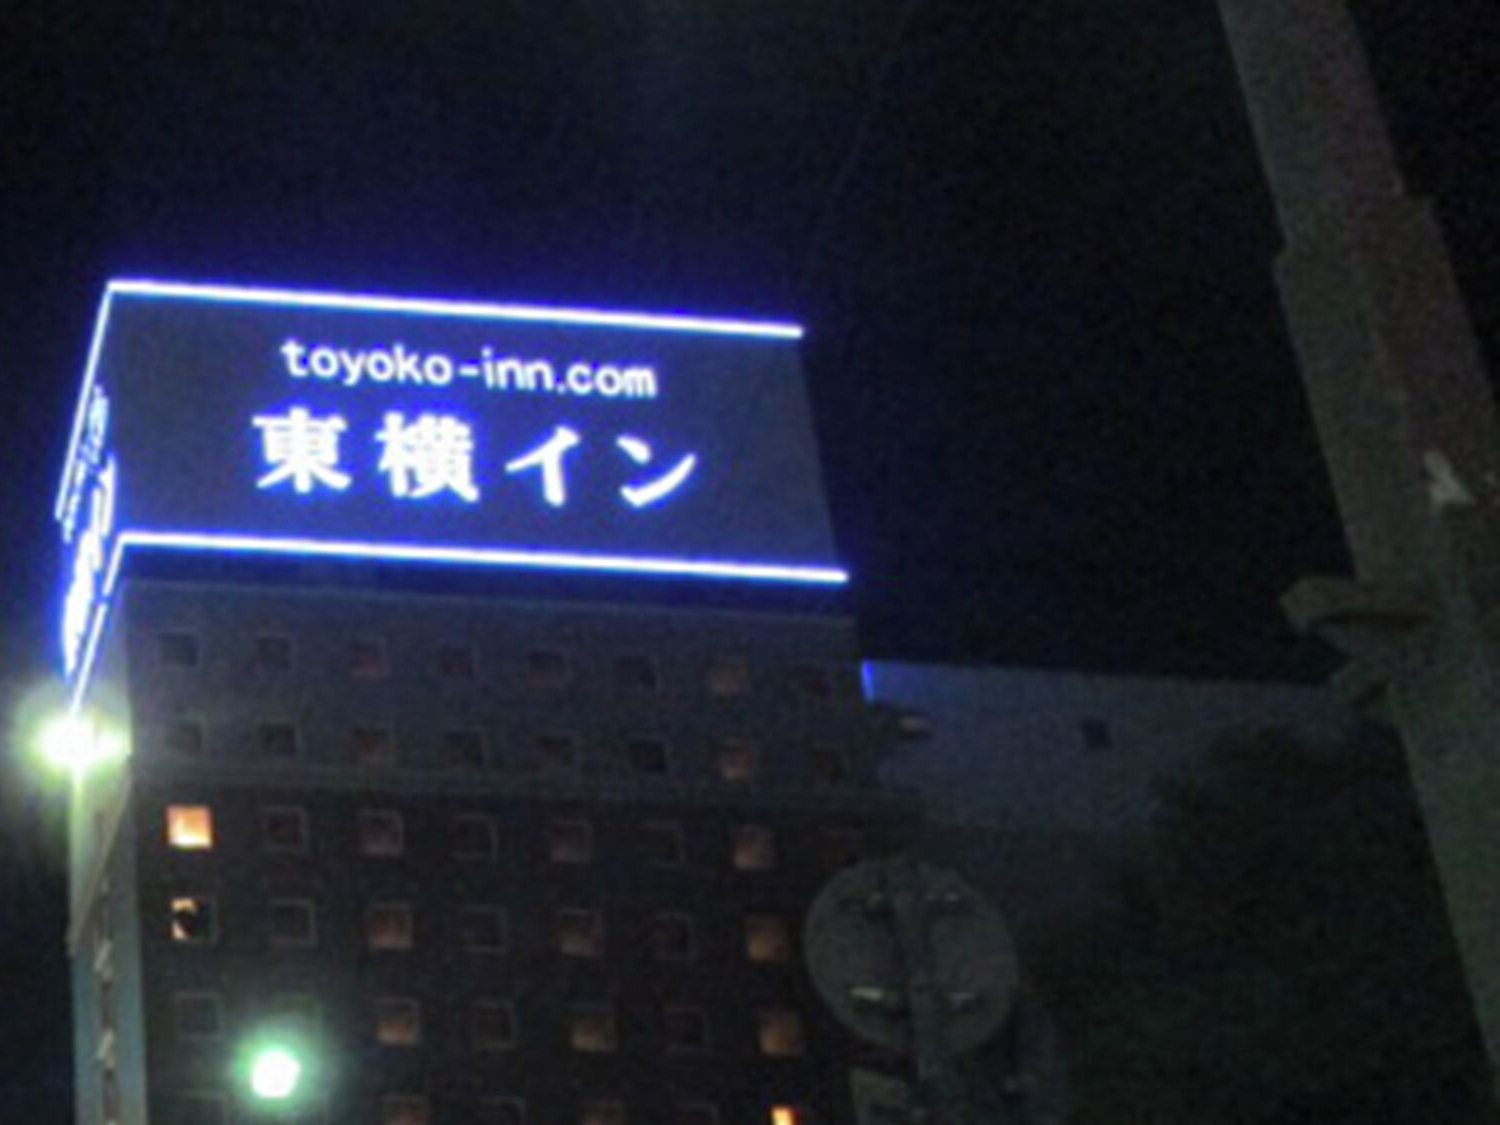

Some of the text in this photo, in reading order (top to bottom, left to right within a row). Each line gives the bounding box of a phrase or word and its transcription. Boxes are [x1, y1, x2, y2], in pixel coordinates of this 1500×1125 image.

[281, 338, 657, 398] toyoko-inn.com
[251, 406, 696, 507] 東横イン
